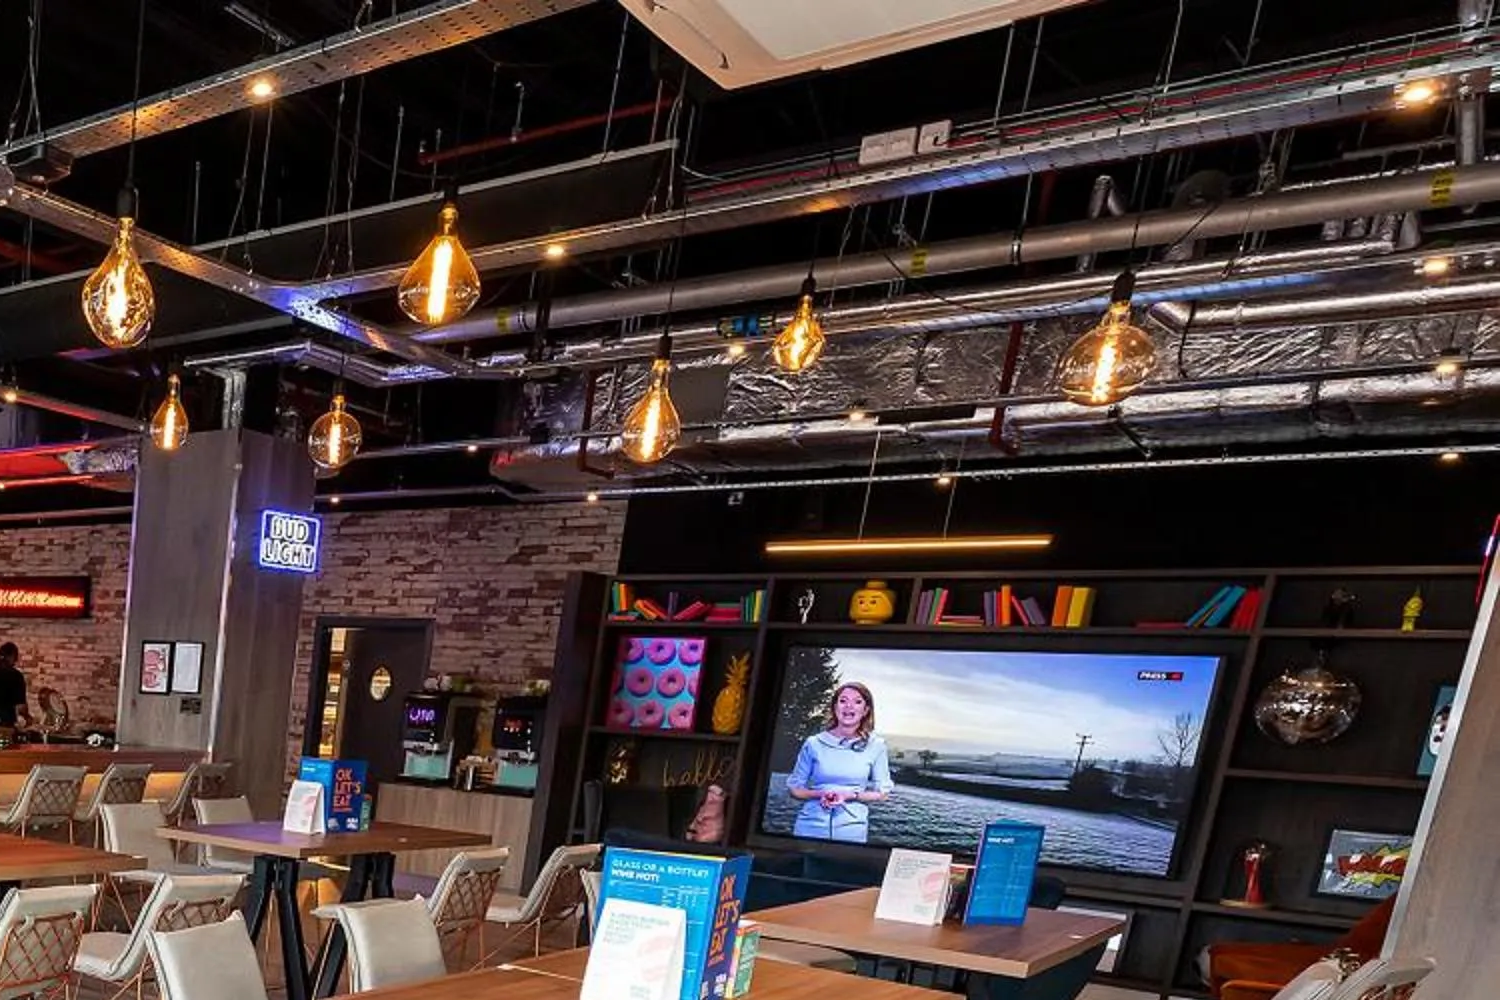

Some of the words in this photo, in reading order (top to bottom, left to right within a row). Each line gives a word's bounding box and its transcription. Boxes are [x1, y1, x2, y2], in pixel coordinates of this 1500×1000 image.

[271, 516, 309, 543] BUD
[264, 539, 316, 567] LIGHT
[720, 874, 737, 901] OK
